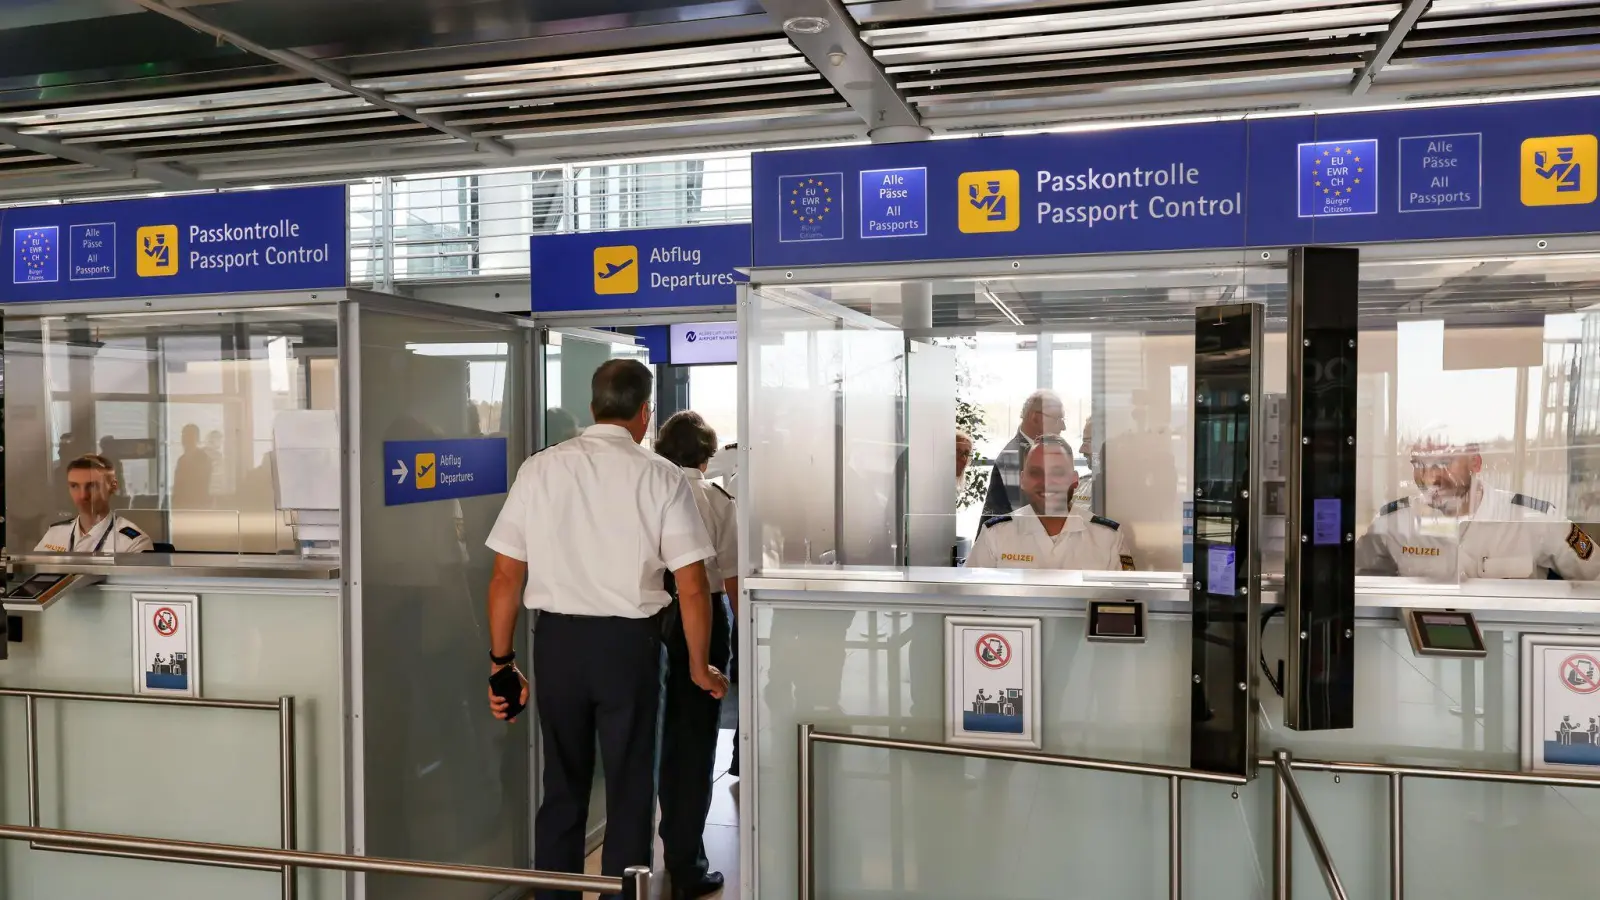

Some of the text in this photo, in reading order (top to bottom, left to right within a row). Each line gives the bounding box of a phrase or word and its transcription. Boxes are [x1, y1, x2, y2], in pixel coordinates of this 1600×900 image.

[1427, 141, 1453, 153] Alle
[1331, 157, 1344, 166] EU
[1423, 156, 1458, 169] Pässe
[1037, 162, 1200, 193] Passkontrolle
[1327, 167, 1349, 177] EWR
[882, 174, 904, 186] Alle
[1331, 177, 1344, 187] CH
[1430, 176, 1449, 188] All
[805, 188, 816, 197] EU
[879, 188, 908, 200] Pässe
[1409, 191, 1471, 206] Passports
[802, 197, 820, 206] EWR
[1325, 197, 1350, 206] Bürger
[805, 206, 817, 216] CH
[886, 205, 901, 217] All
[1037, 192, 1241, 228] Passport Control
[1323, 205, 1352, 214] Citizens
[189, 219, 300, 243] Passkontrolle
[869, 219, 919, 233] Passports
[85, 228, 100, 237] Alle
[32, 238, 40, 246] EU
[83, 238, 103, 249] Pässe
[29, 246, 43, 254] EWR
[650, 246, 701, 265] Abflug
[31, 254, 40, 262] CH
[87, 254, 98, 263] All
[190, 243, 329, 272] Passport Control
[75, 264, 110, 276] Passports
[651, 271, 734, 292] Departures
[440, 454, 462, 468] Abflug
[440, 472, 474, 486] Departures
[1402, 546, 1440, 556] POLIZEI
[1001, 553, 1034, 562] POLIZEI
